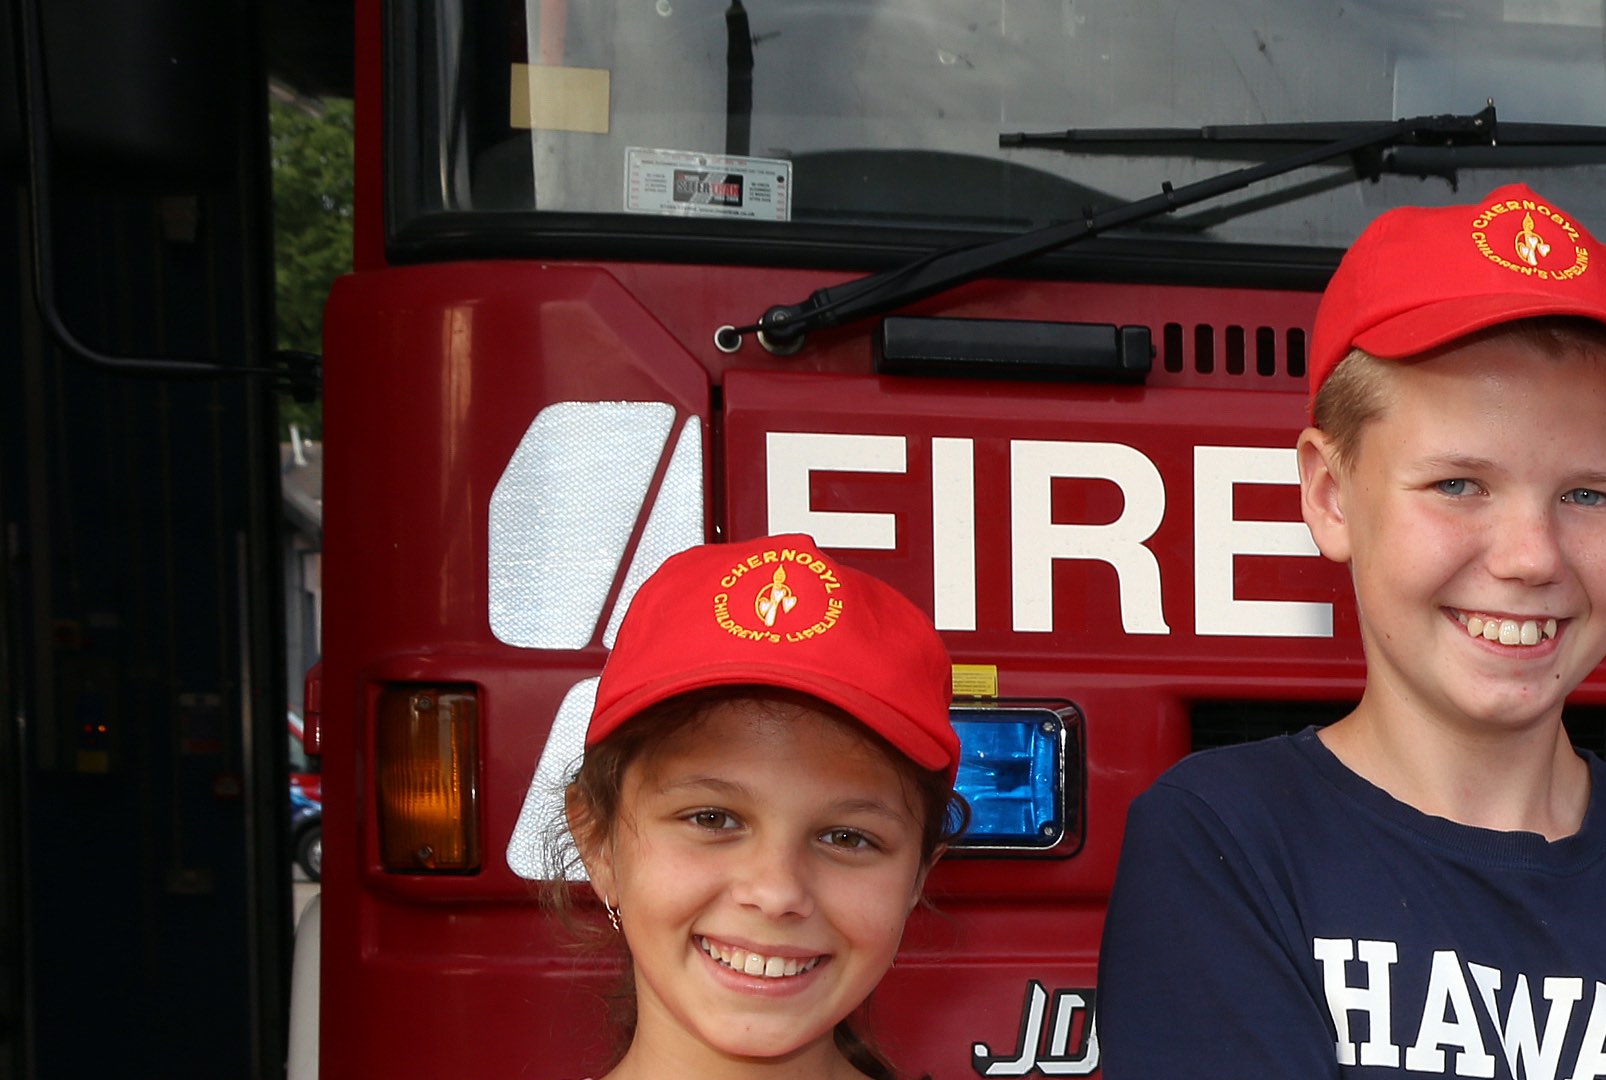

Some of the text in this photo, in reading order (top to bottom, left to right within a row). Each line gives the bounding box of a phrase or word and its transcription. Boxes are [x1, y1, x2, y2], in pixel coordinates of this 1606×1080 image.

[1472, 199, 1580, 243] CHERNOBYL
[1471, 231, 1549, 280] CHILDREN'S
[766, 431, 1335, 638] FIRE
[720, 548, 841, 594] CHERNOBYL
[713, 593, 843, 643] CHILDREN'S LIFELINE
